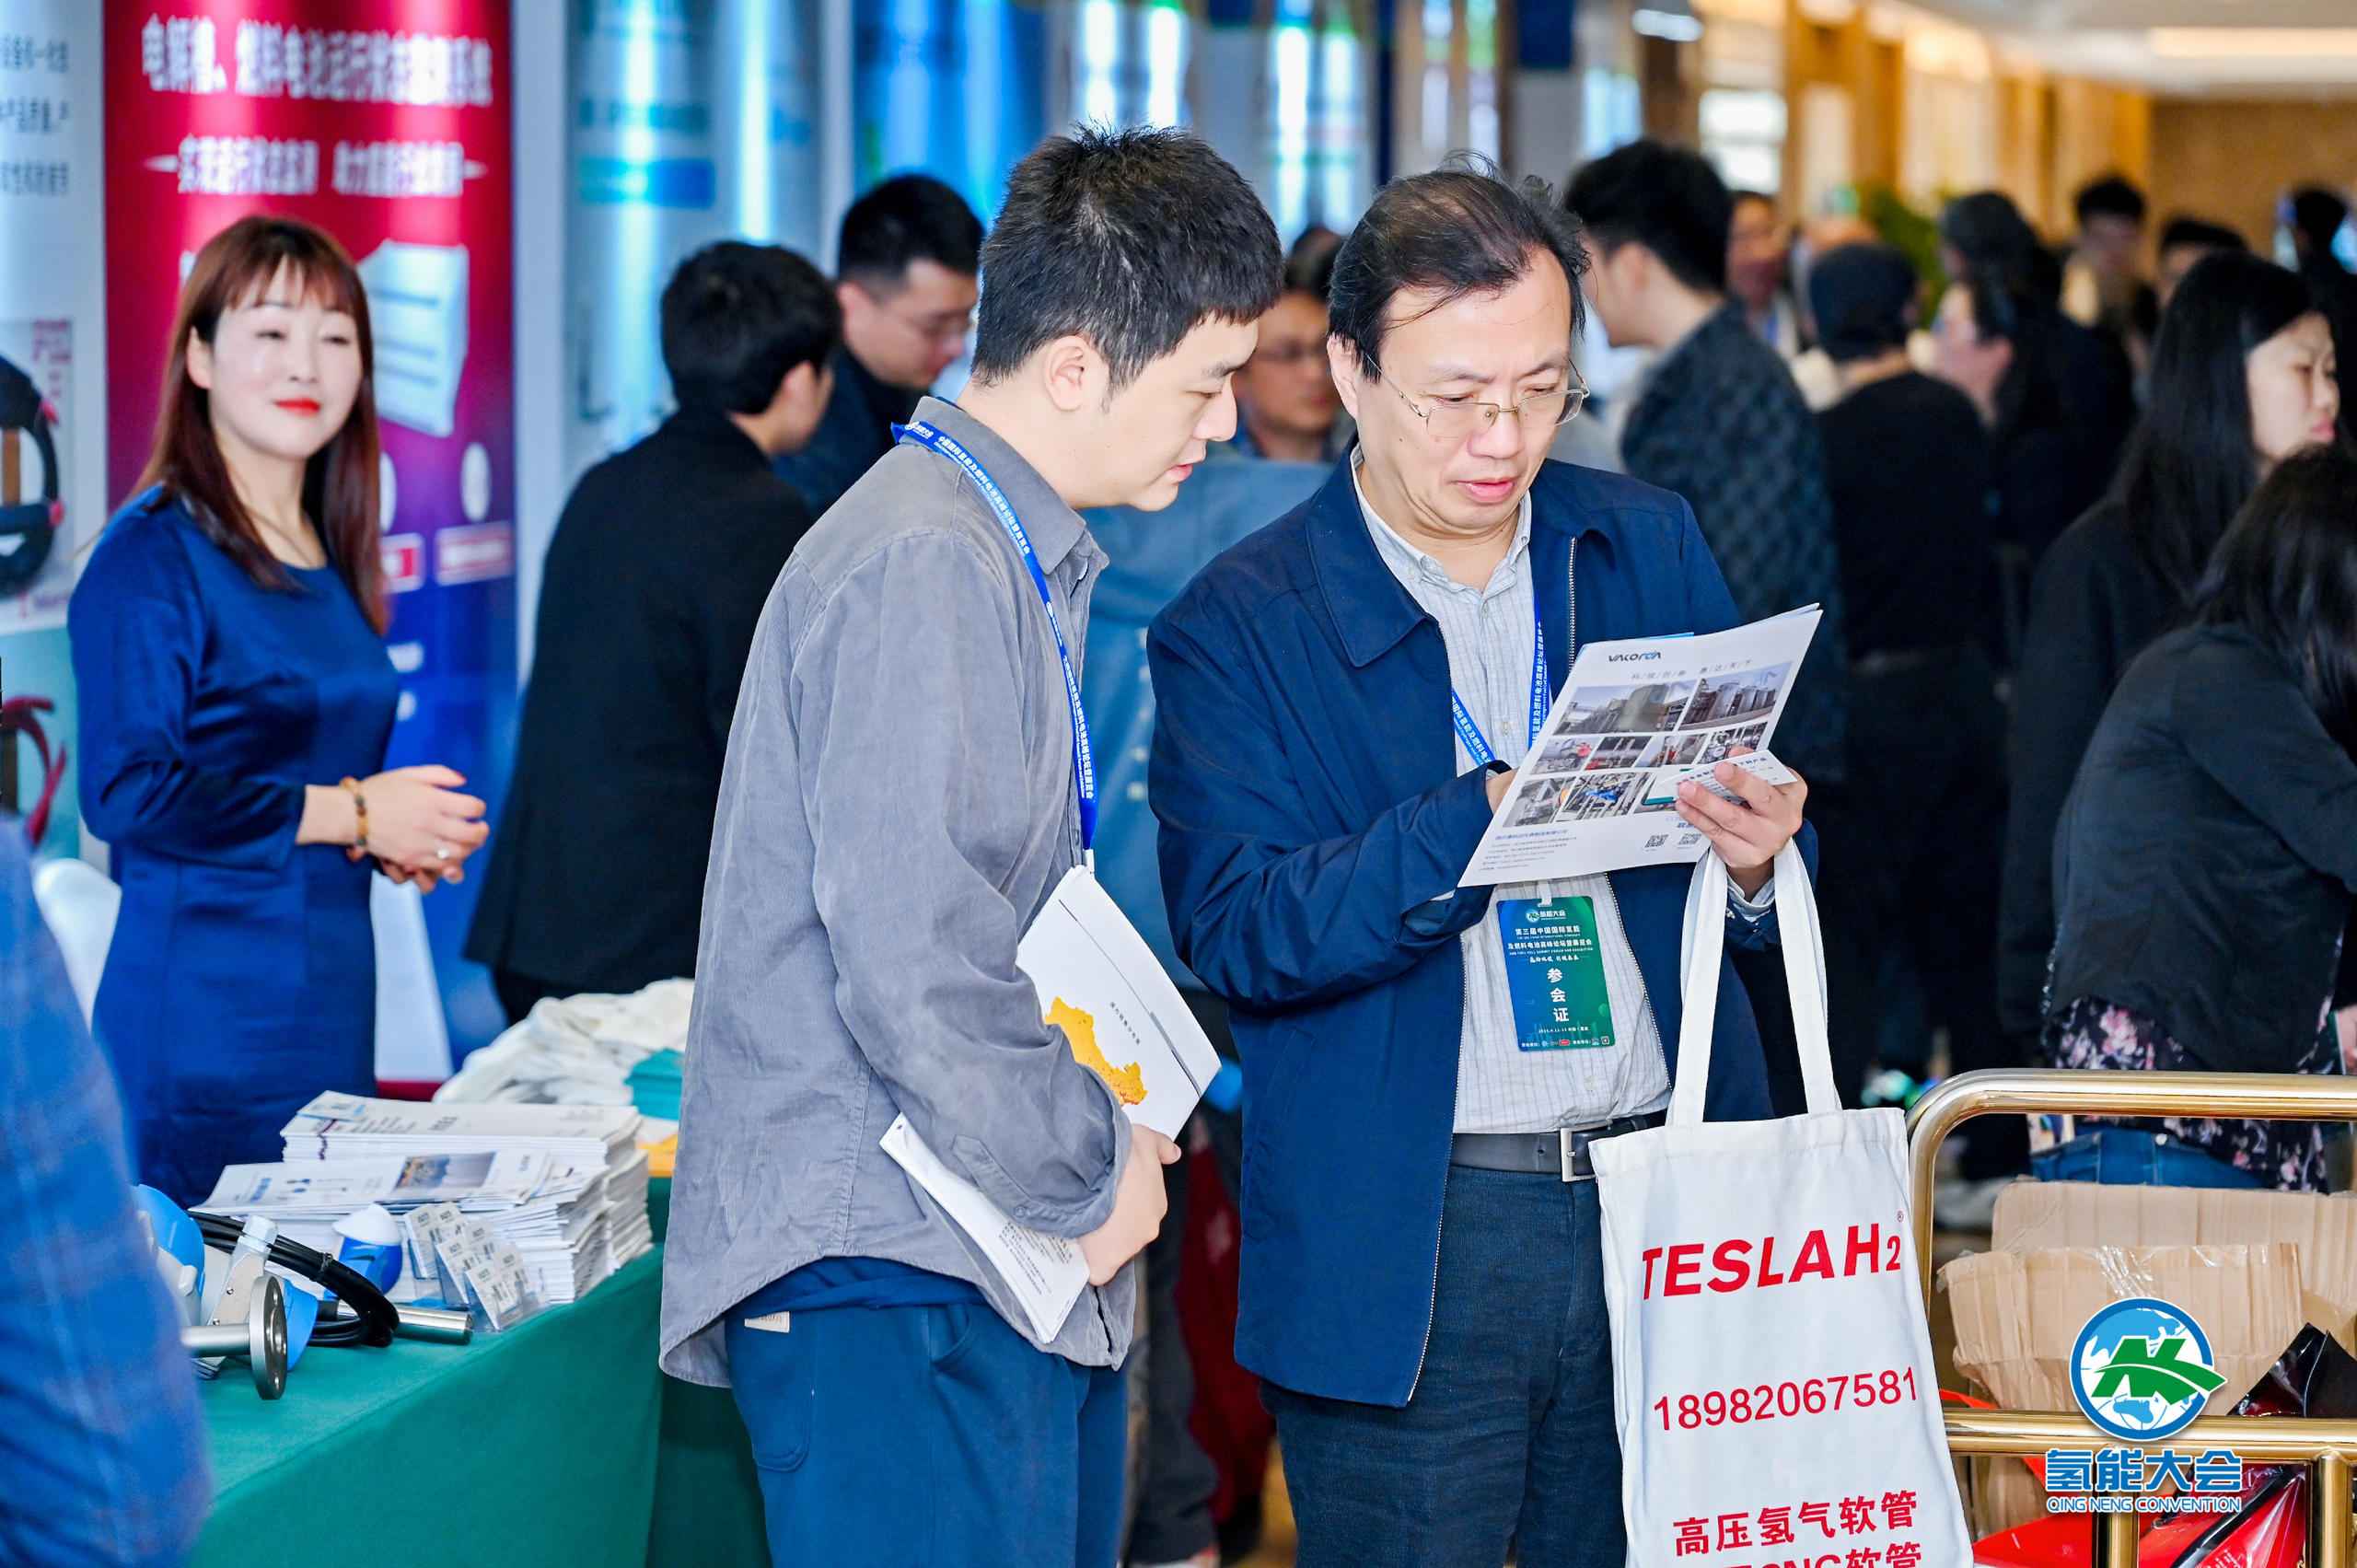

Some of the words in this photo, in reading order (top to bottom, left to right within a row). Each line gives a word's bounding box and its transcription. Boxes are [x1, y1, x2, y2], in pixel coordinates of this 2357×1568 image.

[1547, 968, 1569, 1022] 参会证
[1654, 1366, 1918, 1431] 18982067581
[1673, 1490, 1918, 1557] 高压氢气软管
